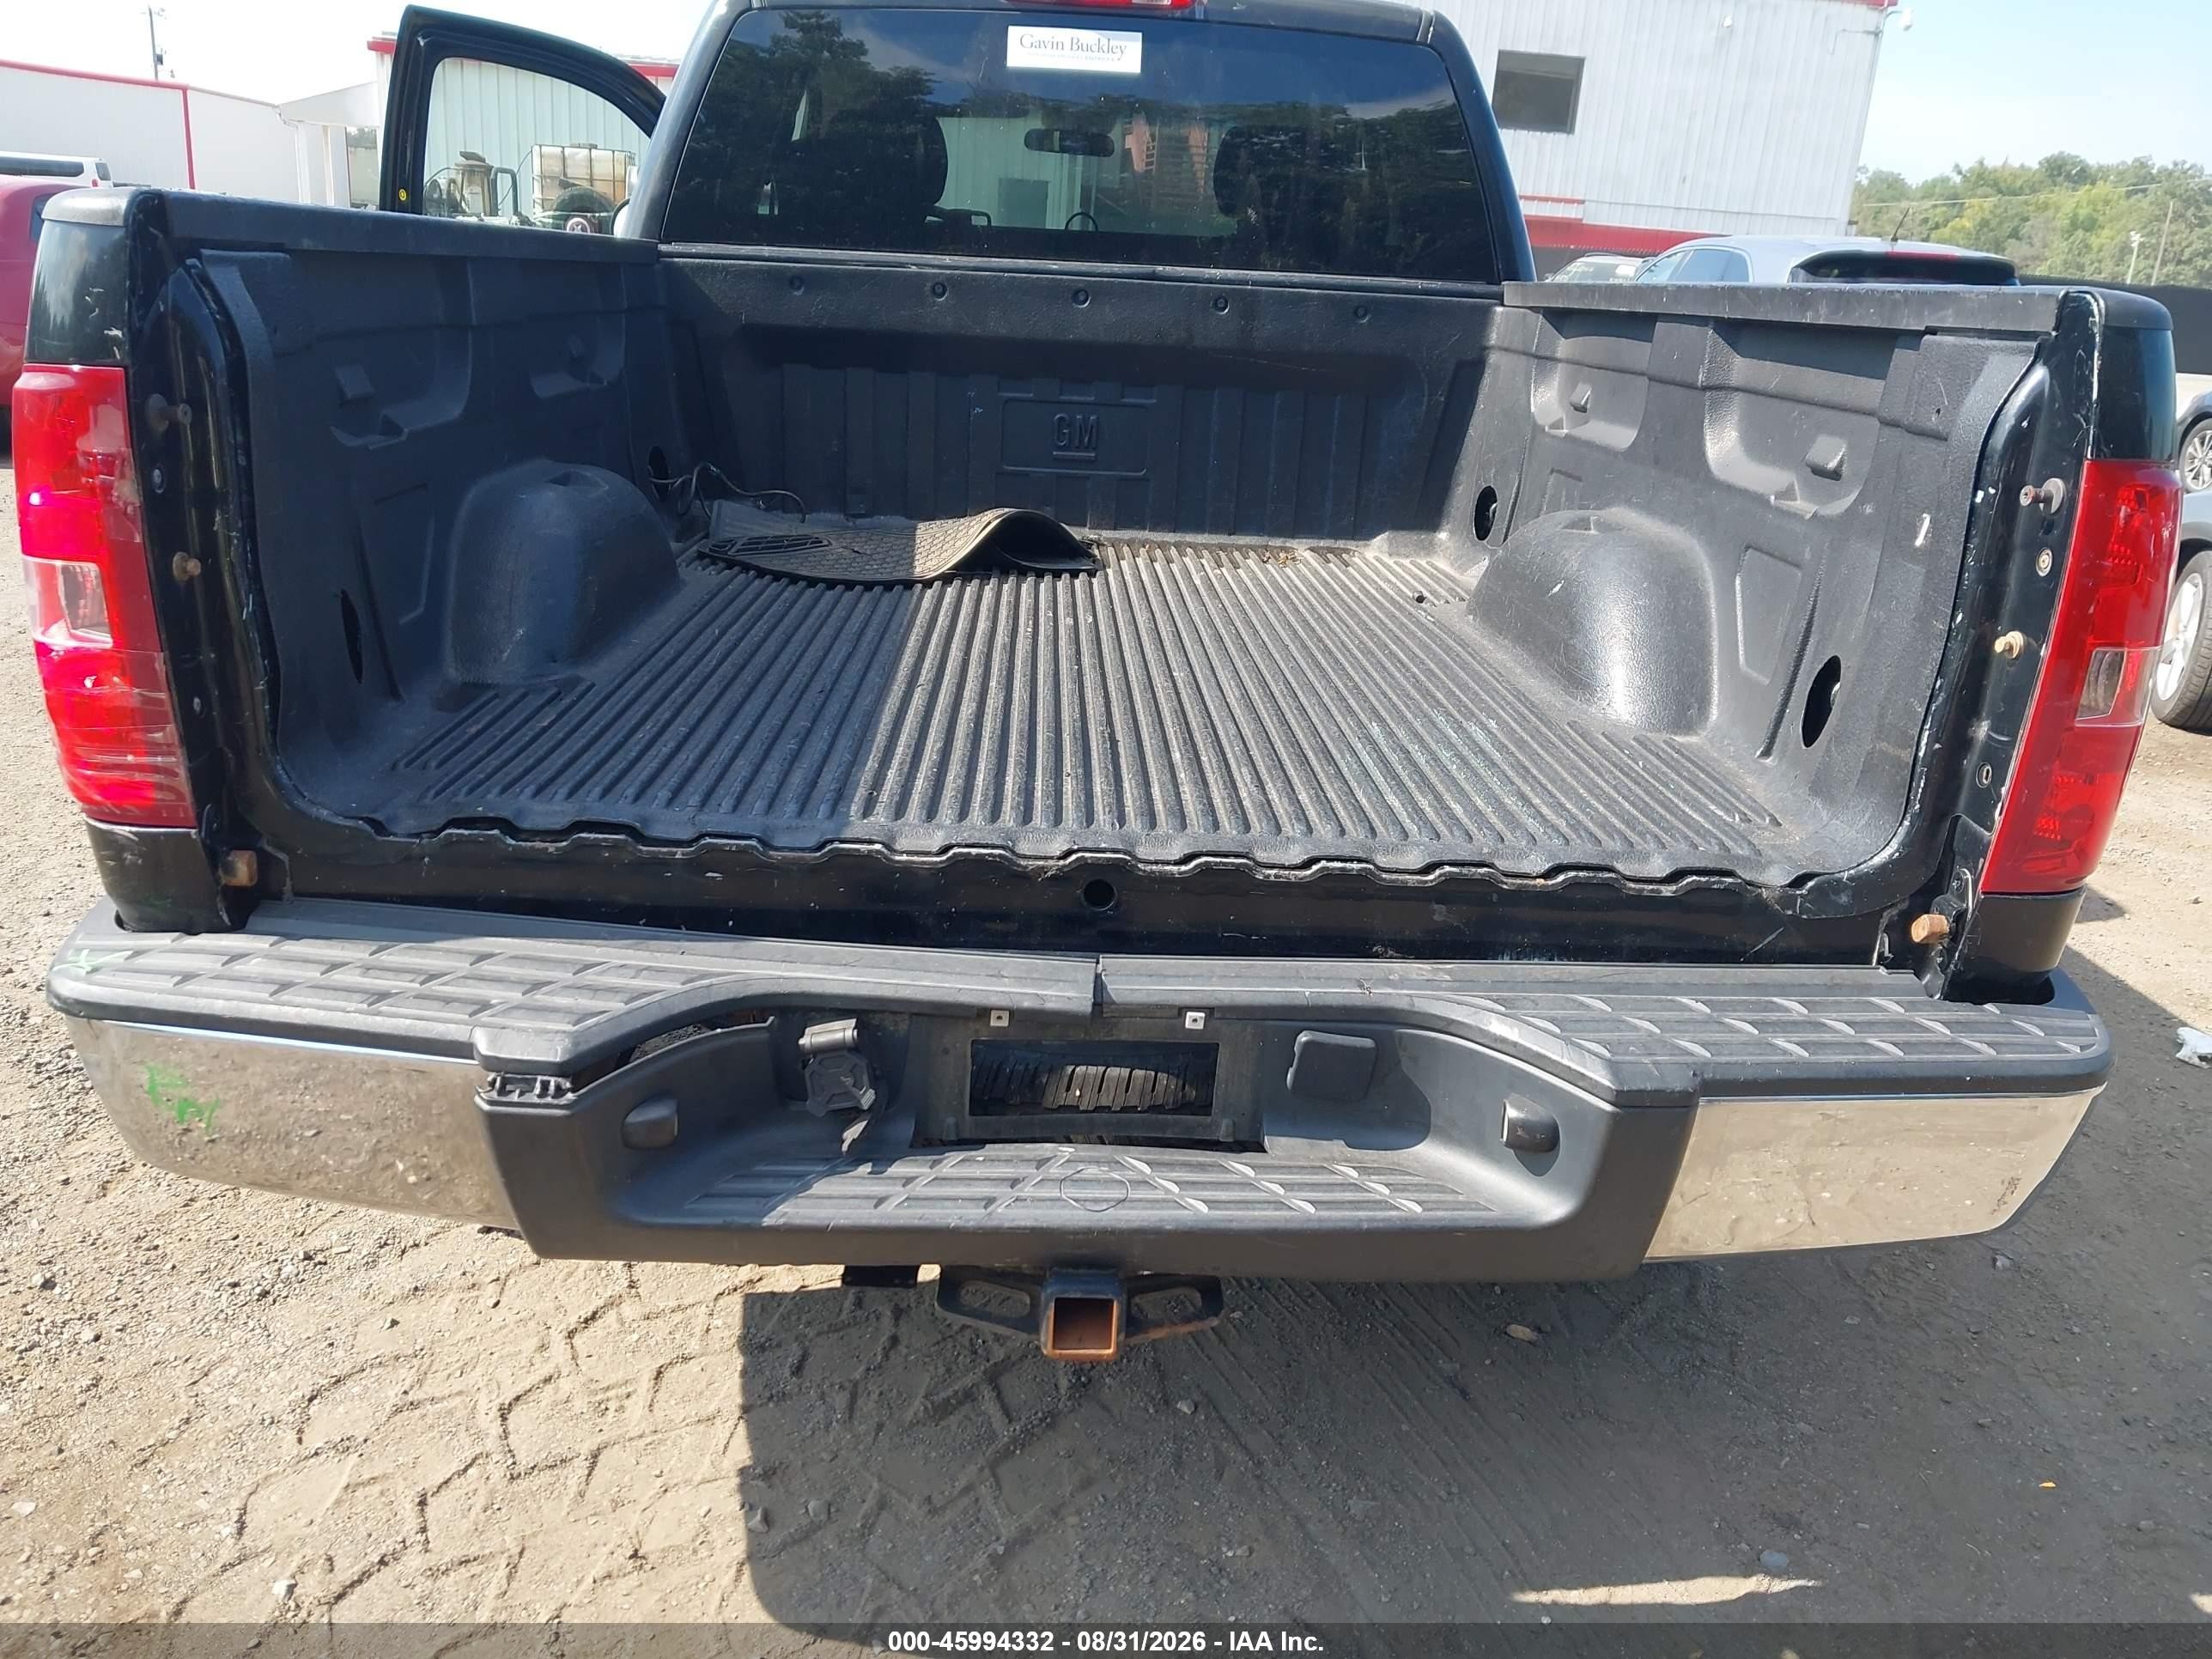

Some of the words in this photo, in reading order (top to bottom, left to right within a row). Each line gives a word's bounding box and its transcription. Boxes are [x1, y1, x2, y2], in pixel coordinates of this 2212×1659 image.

[1019, 33, 1065, 52] Gavin
[1069, 36, 1127, 61] Buckley
[1053, 413, 1099, 450] GM
